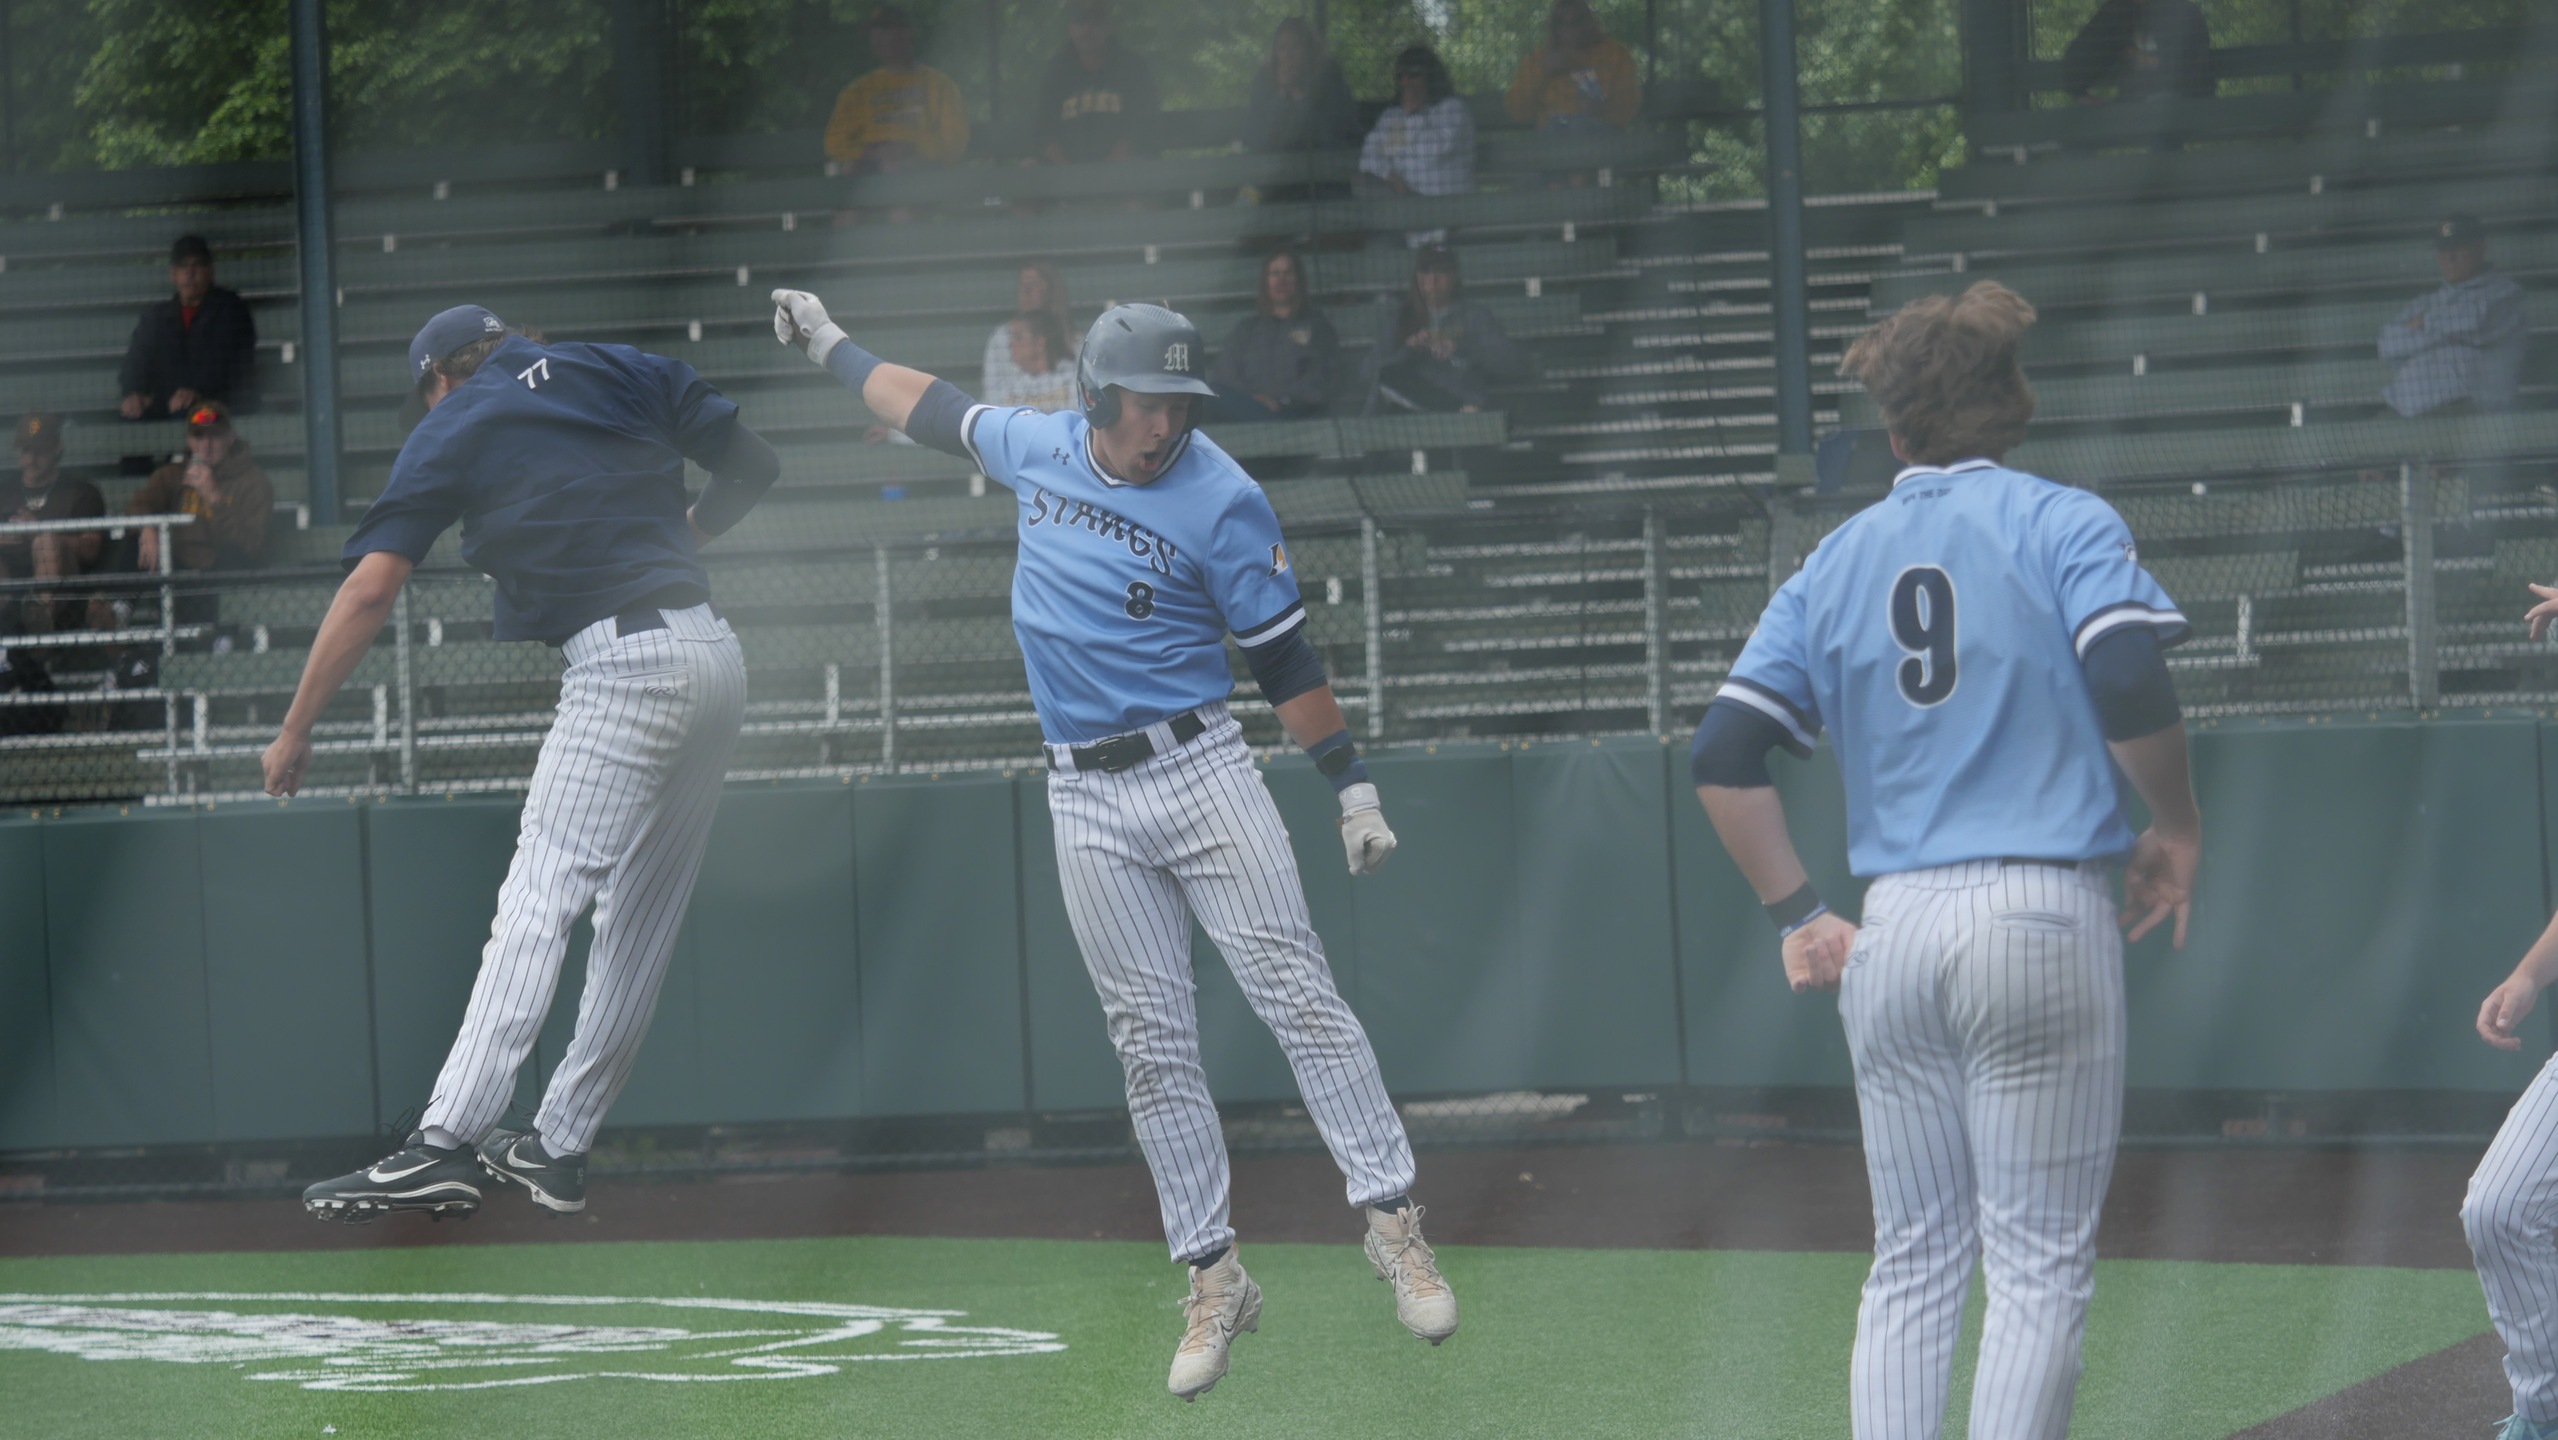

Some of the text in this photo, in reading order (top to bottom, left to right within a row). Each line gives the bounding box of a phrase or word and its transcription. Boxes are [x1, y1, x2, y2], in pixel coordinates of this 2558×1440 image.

[516, 357, 550, 390] 77
[1124, 579, 1156, 621] 8
[1887, 563, 1959, 709] 9
